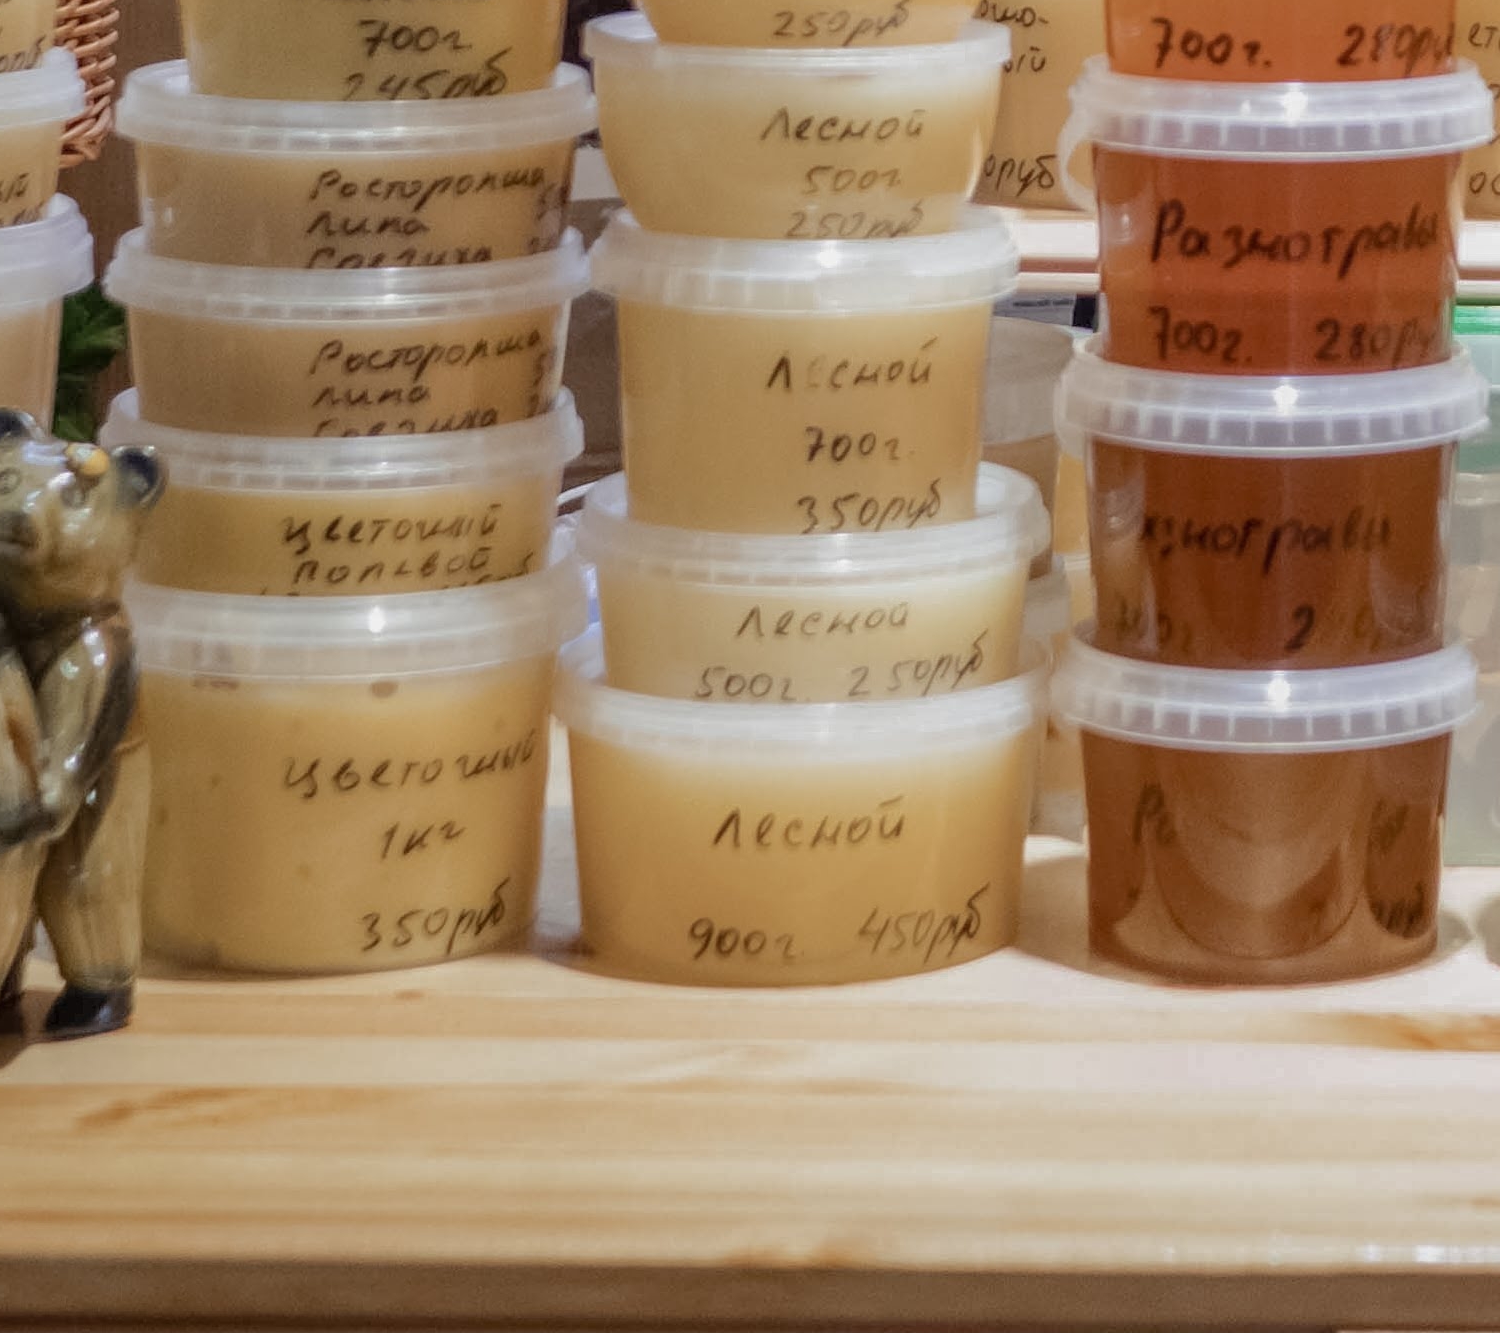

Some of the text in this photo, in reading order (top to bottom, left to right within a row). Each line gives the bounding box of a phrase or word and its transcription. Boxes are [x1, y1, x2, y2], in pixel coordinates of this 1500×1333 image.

[760, 106, 924, 143] Лесной
[766, 336, 938, 393] Лесной
[737, 601, 912, 638] Лесной
[847, 629, 990, 698] 250руб
[713, 795, 908, 850] Лесной
[857, 881, 991, 964] 450руб
